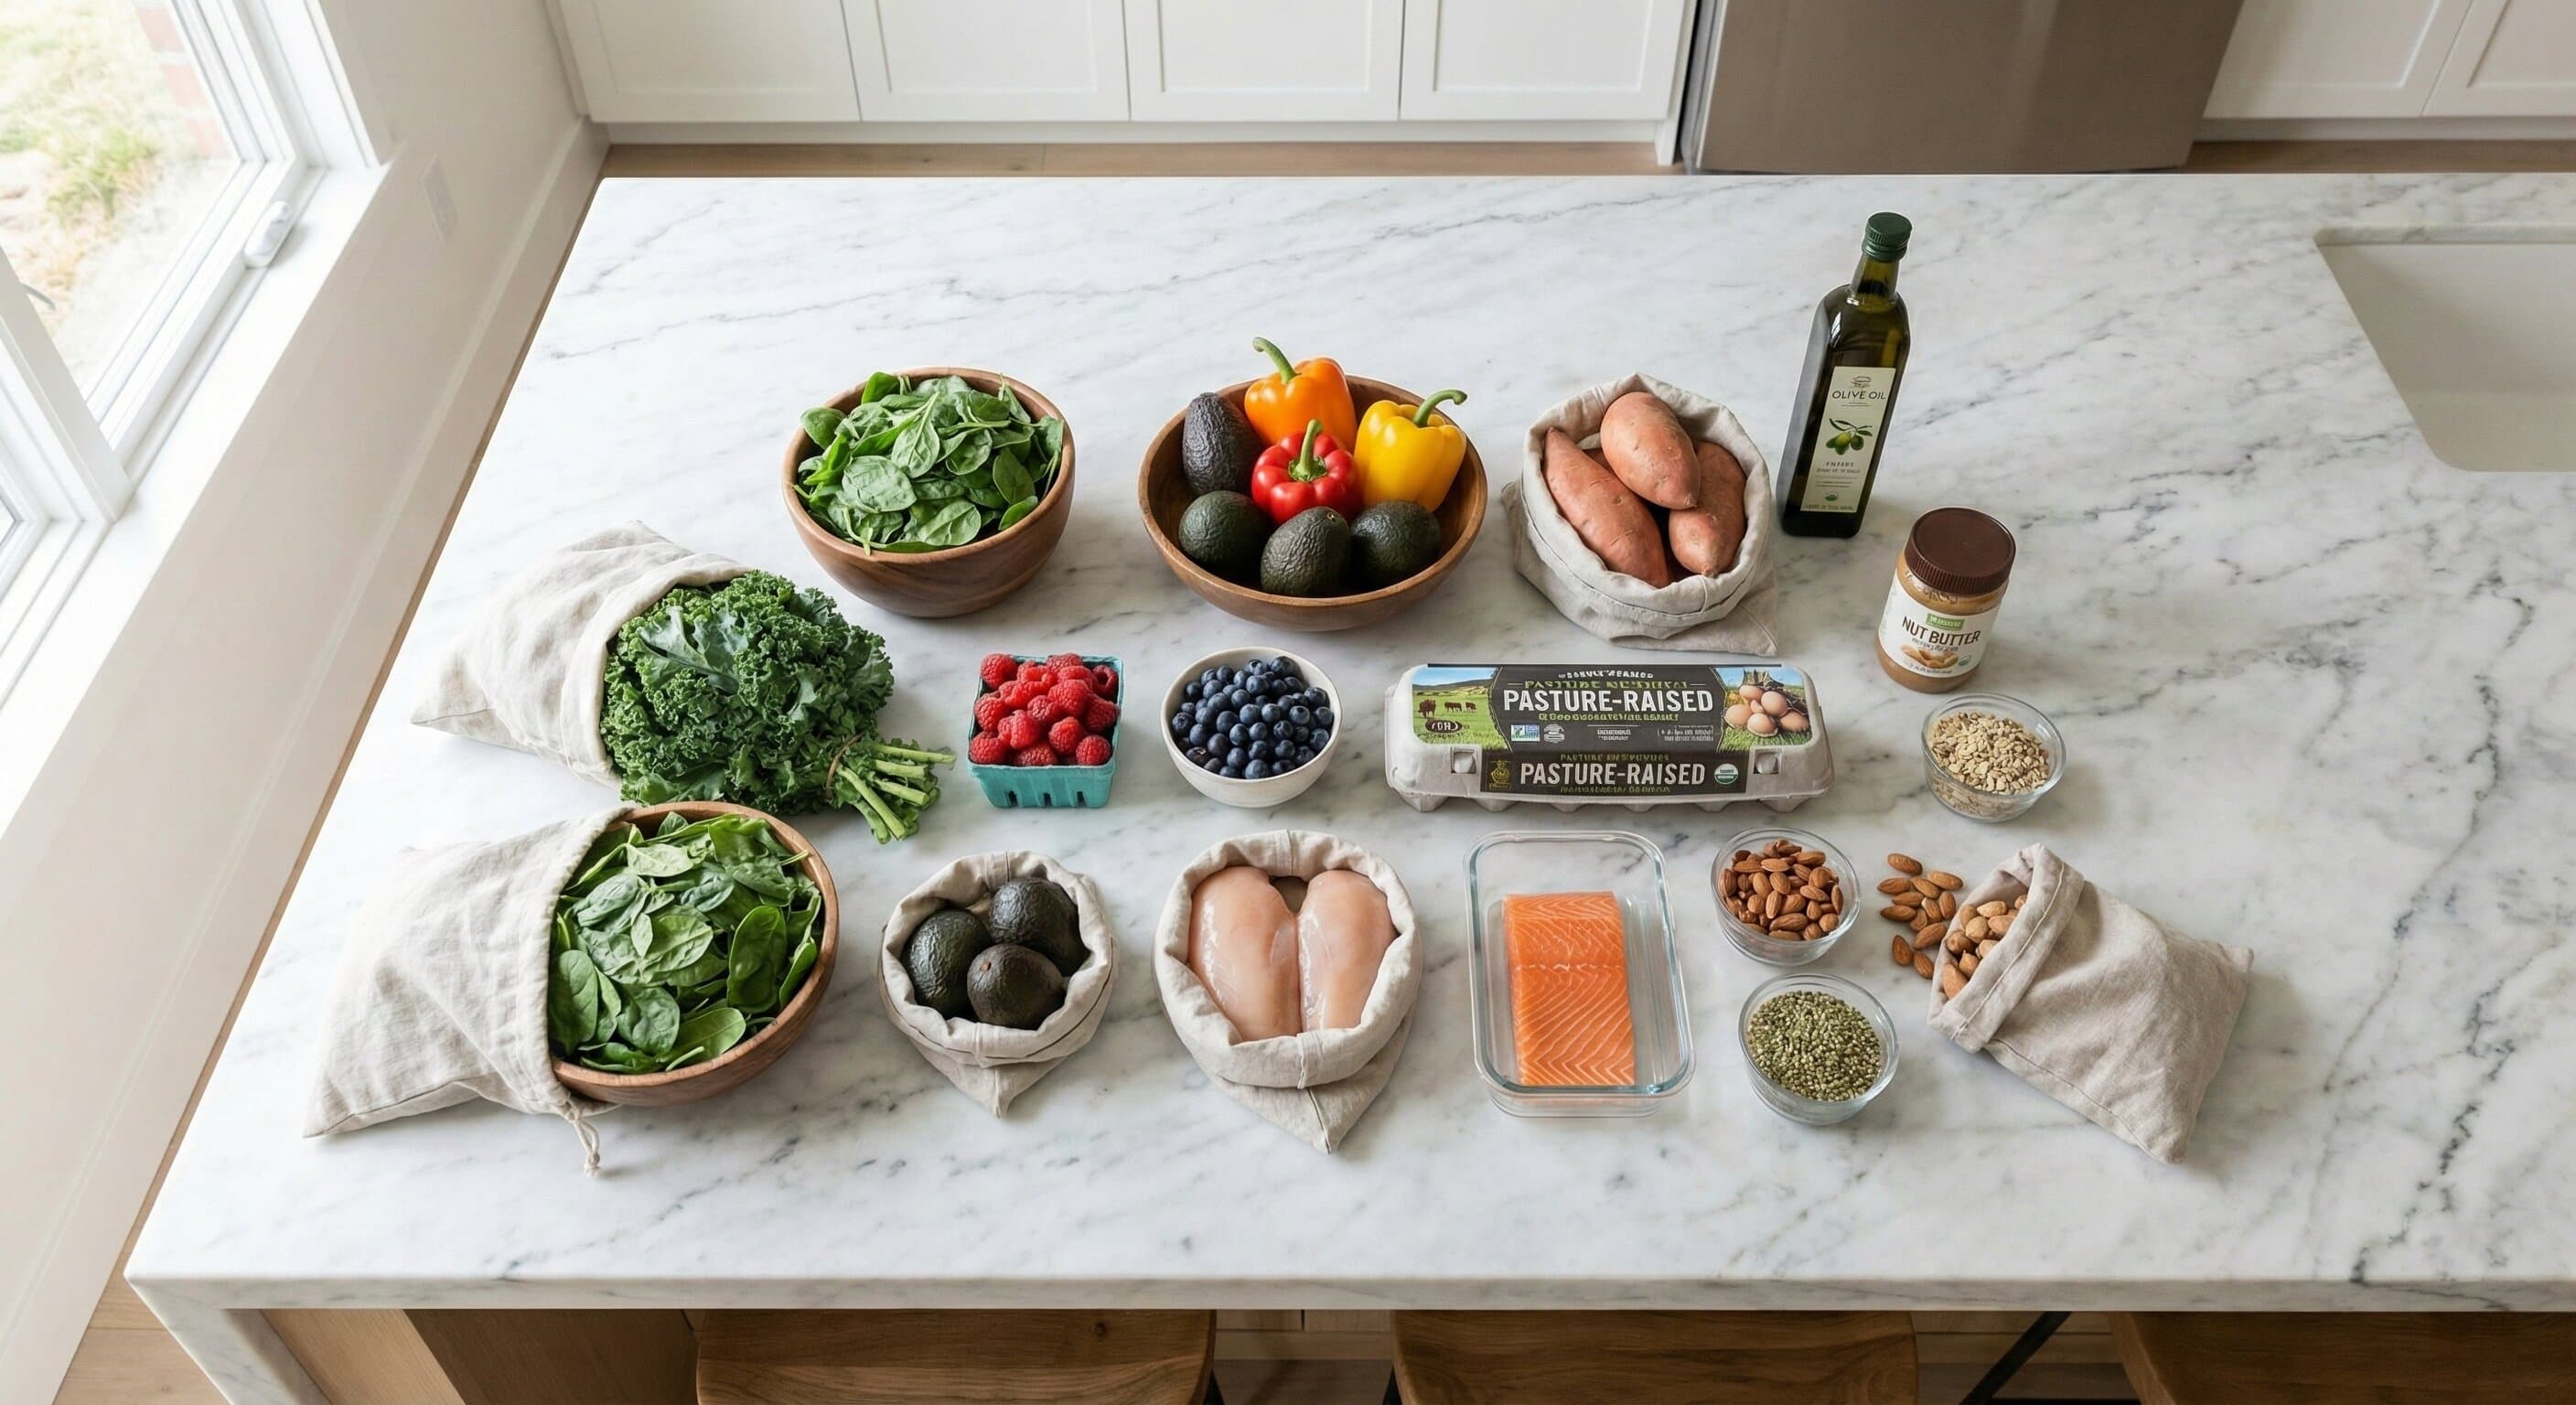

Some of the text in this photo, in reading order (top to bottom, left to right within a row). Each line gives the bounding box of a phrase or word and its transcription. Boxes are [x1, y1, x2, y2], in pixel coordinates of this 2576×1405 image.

[1831, 391, 1886, 400] OLIVE OIL
[1902, 616, 1928, 639] NUT
[1928, 629, 1981, 647] BUTTER
[1503, 690, 1713, 712] PASTURE-RAISED
[1520, 763, 1705, 785] PASTURE-RAISED
